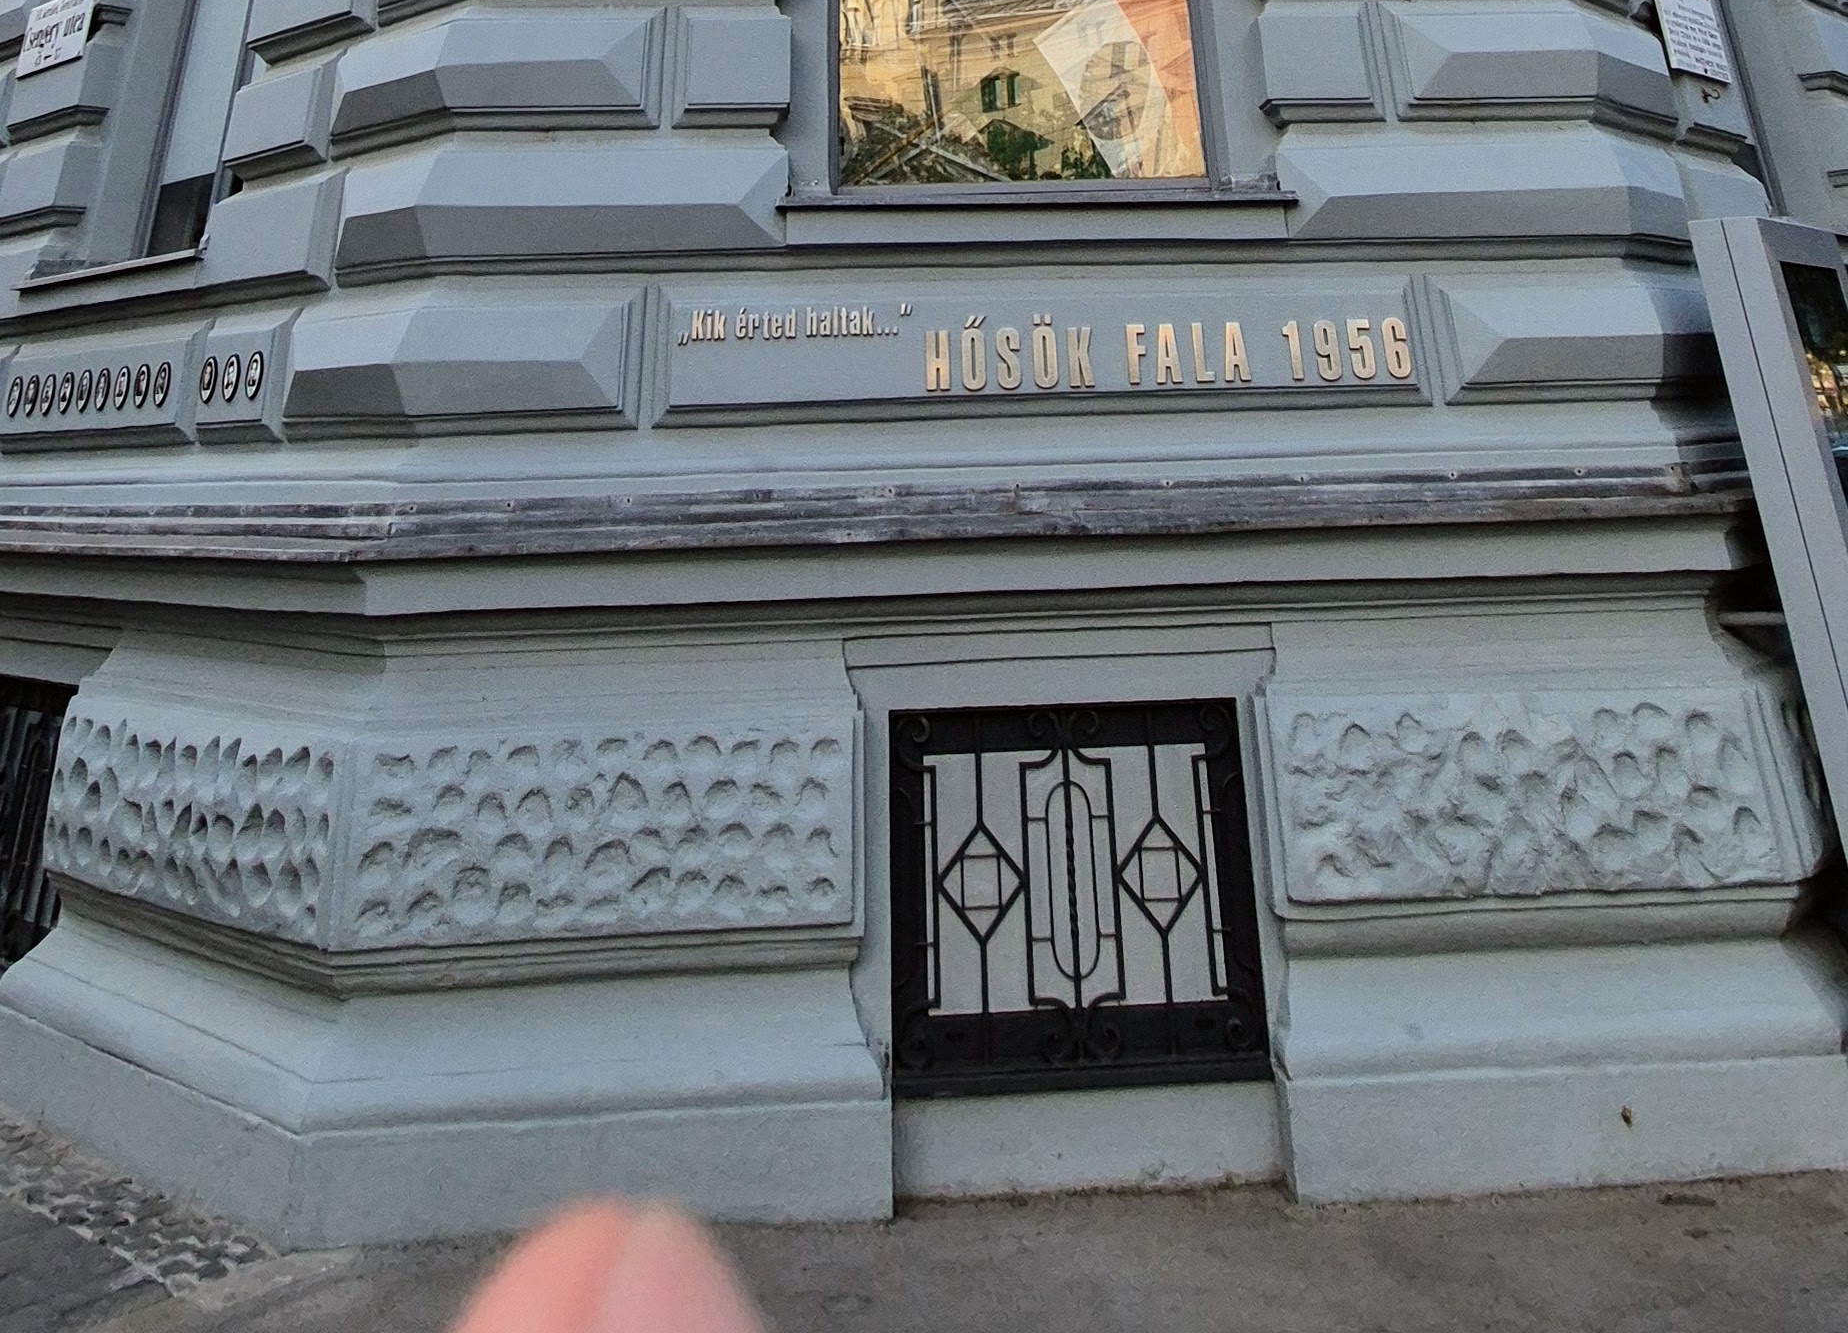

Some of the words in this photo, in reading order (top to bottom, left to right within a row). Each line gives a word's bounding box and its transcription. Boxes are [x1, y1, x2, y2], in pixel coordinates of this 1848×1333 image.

[734, 306, 797, 340] érted
[925, 314, 1096, 392] HŐSÖK
[1125, 322, 1253, 385] FALA
[1281, 316, 1414, 382] 1956
